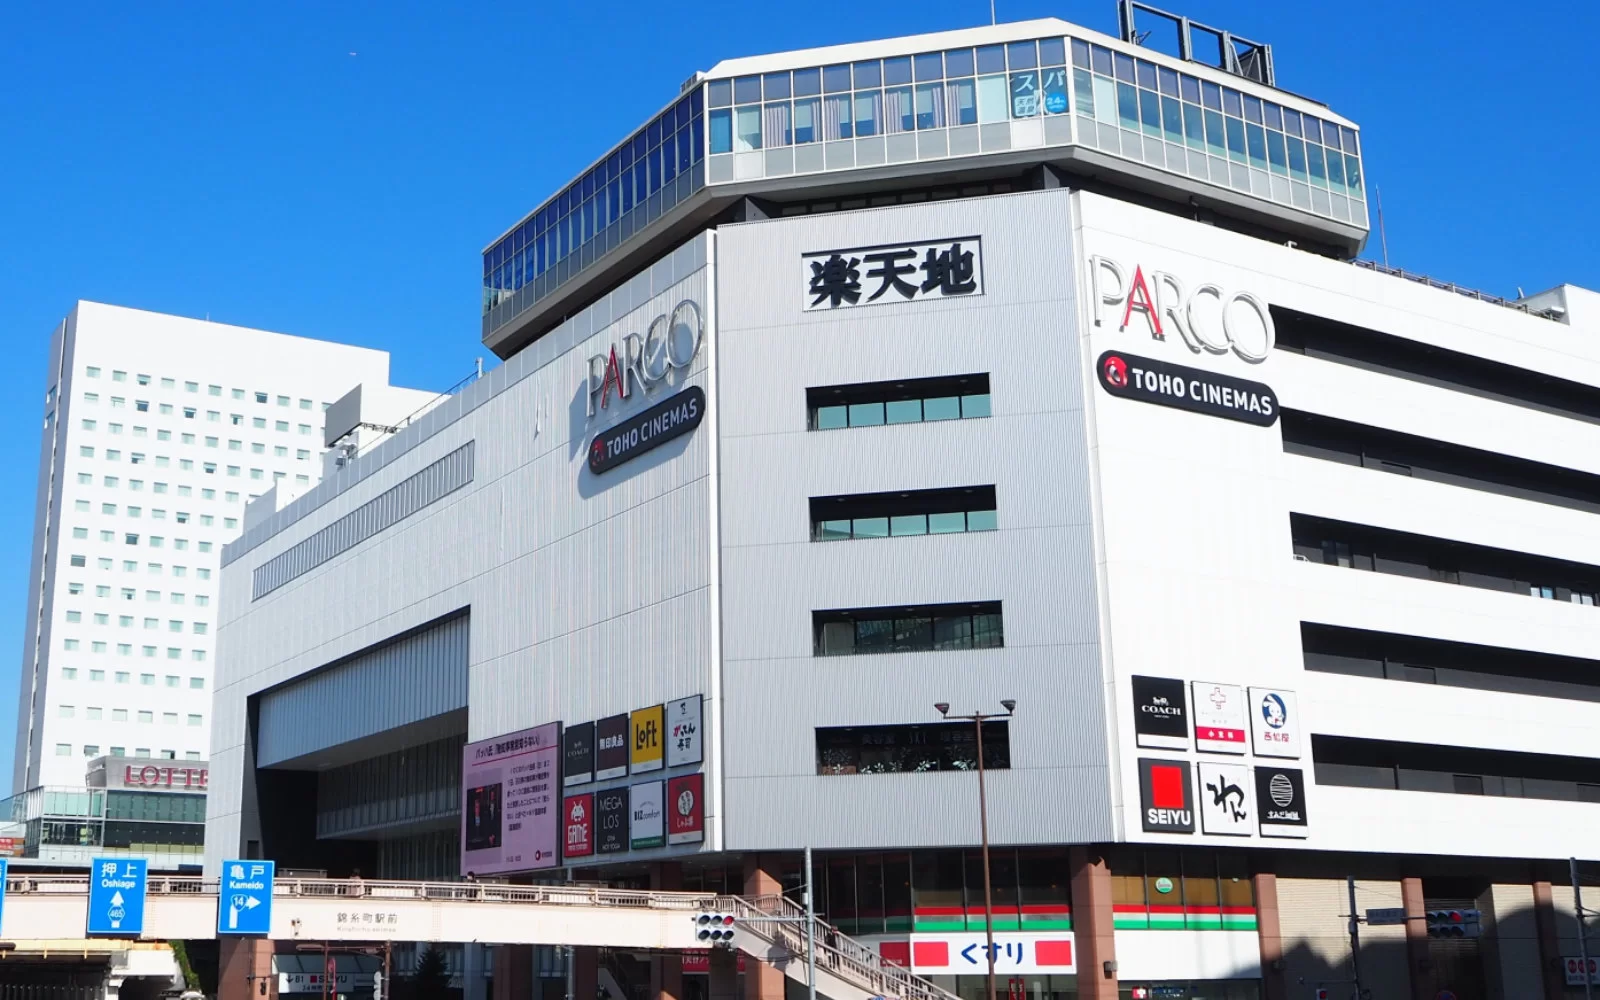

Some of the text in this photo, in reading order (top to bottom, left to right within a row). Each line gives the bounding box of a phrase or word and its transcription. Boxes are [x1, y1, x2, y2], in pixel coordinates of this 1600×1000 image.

[1015, 70, 1066, 92] スパ
[808, 243, 978, 308] 楽天地
[1089, 254, 1276, 365] PARCO
[586, 299, 703, 417] PARCO
[1131, 368, 1273, 416] TOHO CINEMAS
[606, 398, 698, 459] TOHO CINEMAS
[1141, 704, 1182, 716] COACH
[599, 733, 624, 751] 無印良品
[599, 796, 623, 812] MEGA
[603, 814, 620, 830] LOS
[1148, 808, 1191, 826] SEIYU
[567, 823, 588, 844] GAME
[101, 863, 137, 879] 押上
[230, 865, 265, 880] 亀戸
[101, 879, 136, 891] Oshiage
[229, 880, 265, 890] Kameido
[234, 896, 244, 907] 14
[337, 912, 398, 925] 錦糸町駅前
[960, 942, 1023, 965] くすり
